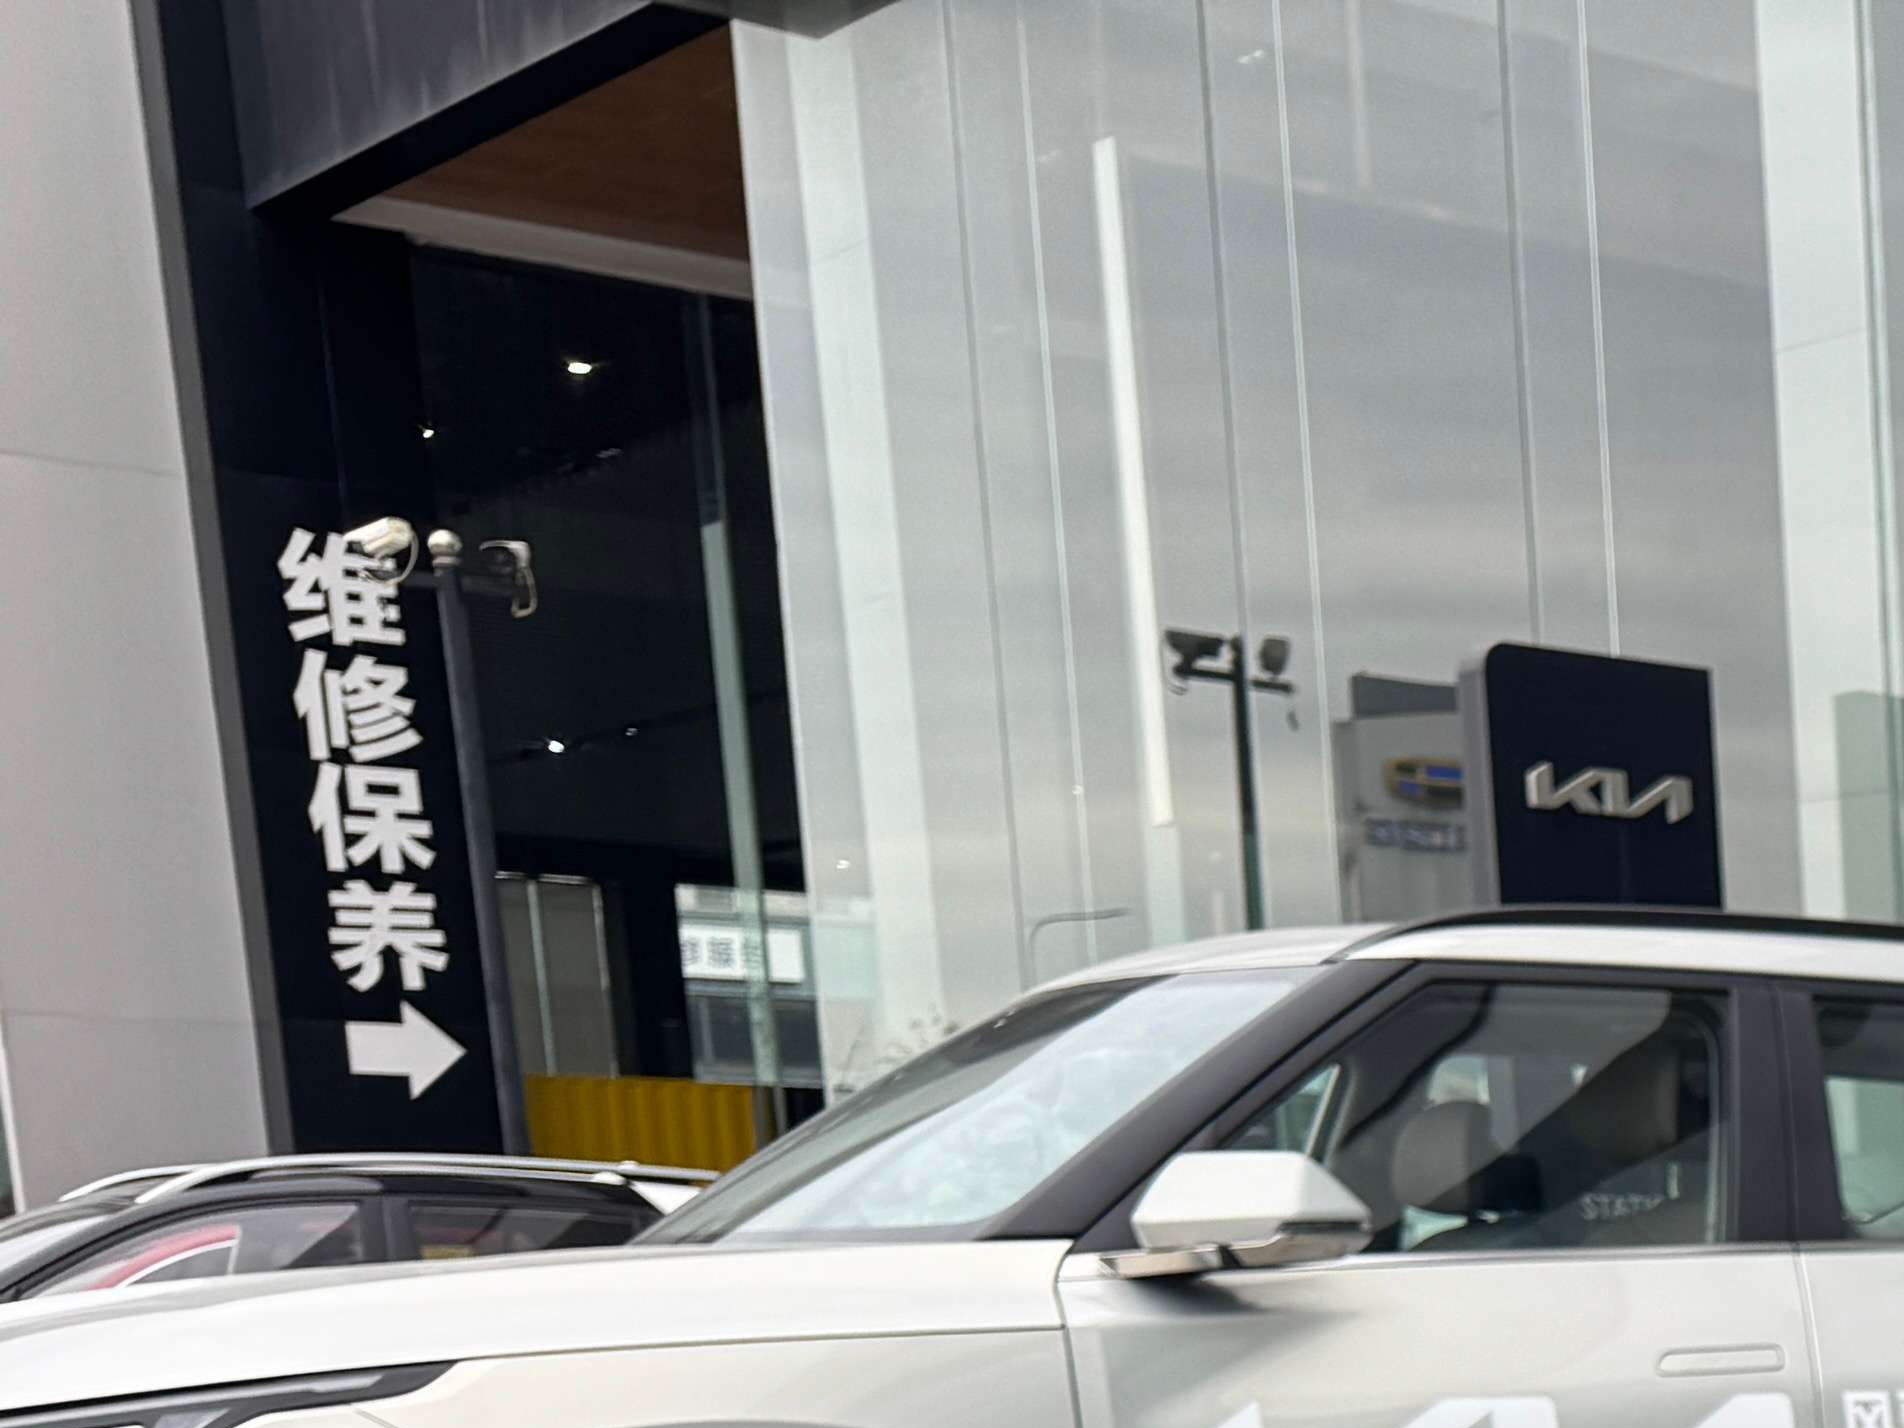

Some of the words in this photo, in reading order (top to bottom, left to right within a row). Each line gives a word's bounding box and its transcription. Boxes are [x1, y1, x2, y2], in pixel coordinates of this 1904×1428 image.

[277, 527, 450, 992] 维修保养
[1525, 761, 1694, 825] KIA
